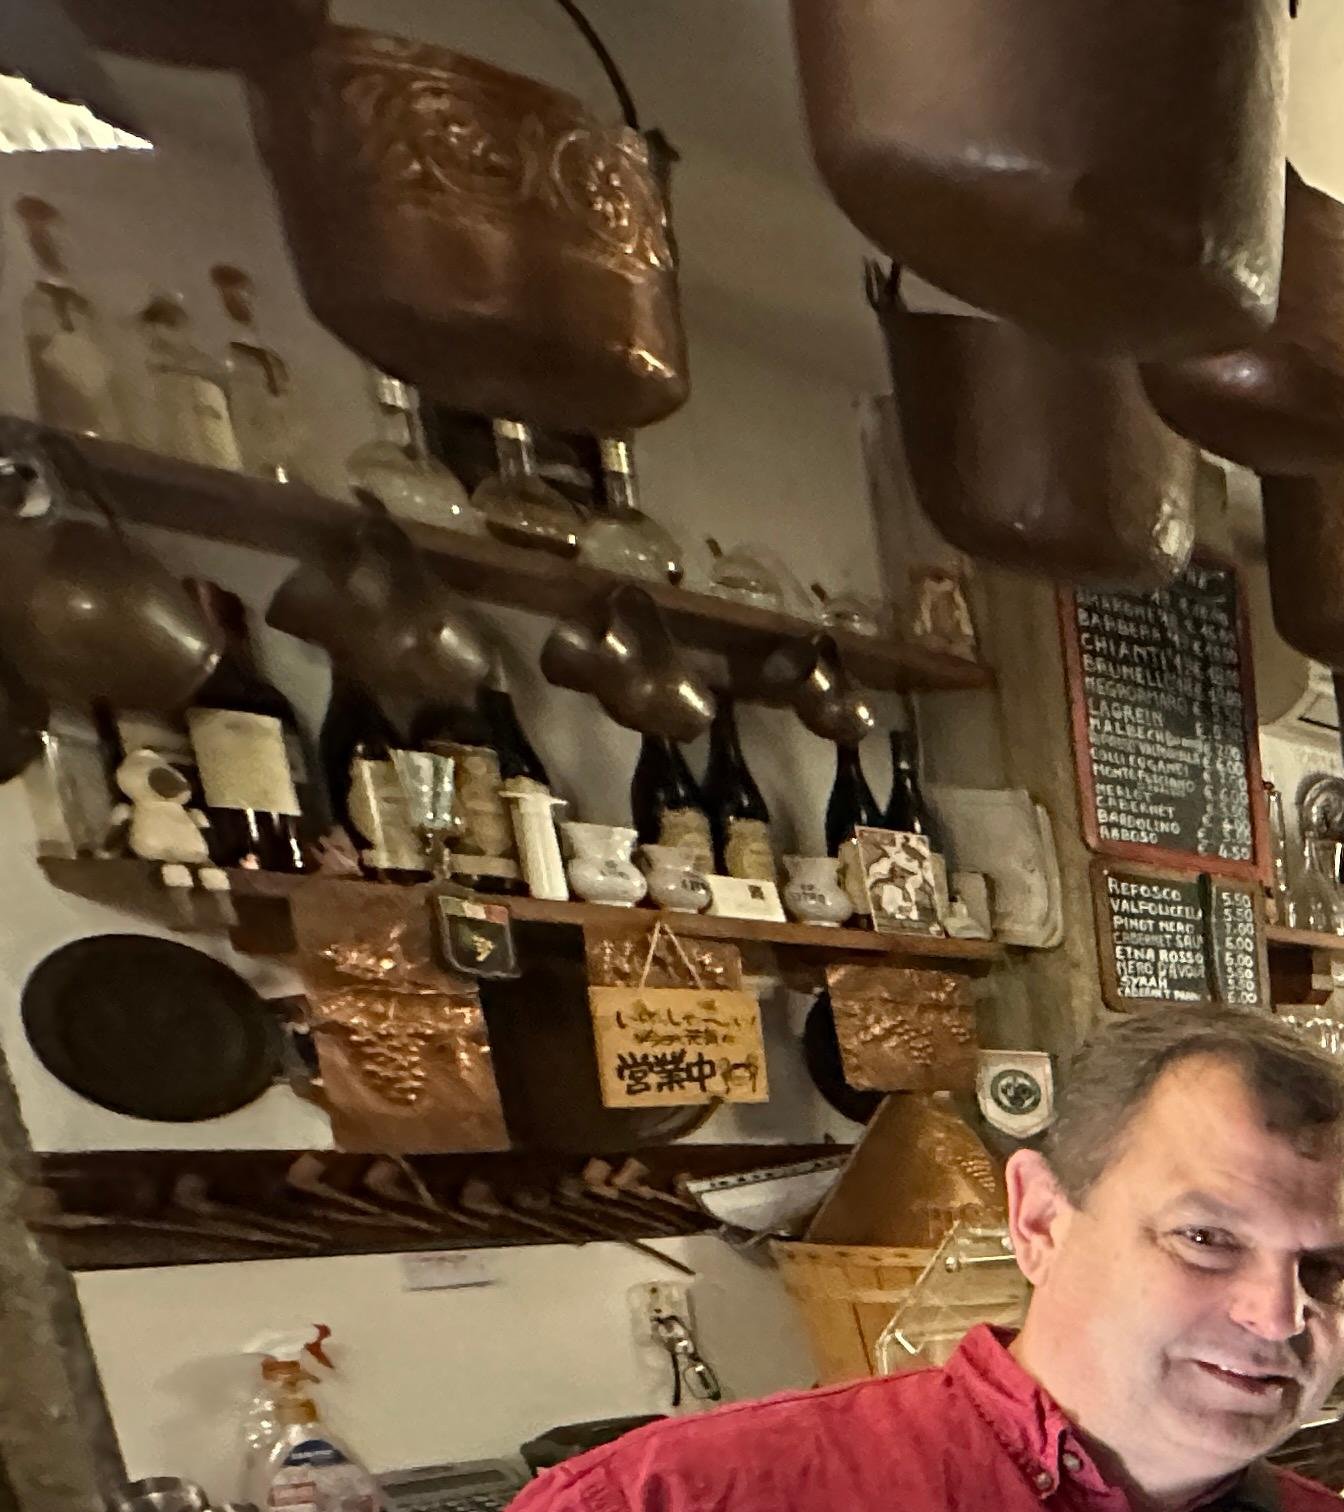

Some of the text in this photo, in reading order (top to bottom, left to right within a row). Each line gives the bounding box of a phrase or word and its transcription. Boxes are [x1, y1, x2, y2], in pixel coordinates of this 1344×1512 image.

[1081, 632, 1167, 670] CHIANTI
[1087, 697, 1164, 727] LAGREIN
[1097, 808, 1181, 835] BARDOLINO
[1107, 877, 1251, 908] REFOSCO 5.50
[1113, 915, 1154, 932] PINOT
[1115, 946, 1155, 961] ETNA
[1159, 949, 1204, 964] ROSSO
[1120, 976, 1168, 989] SYRAH
[615, 1048, 716, 1096] 営業中
